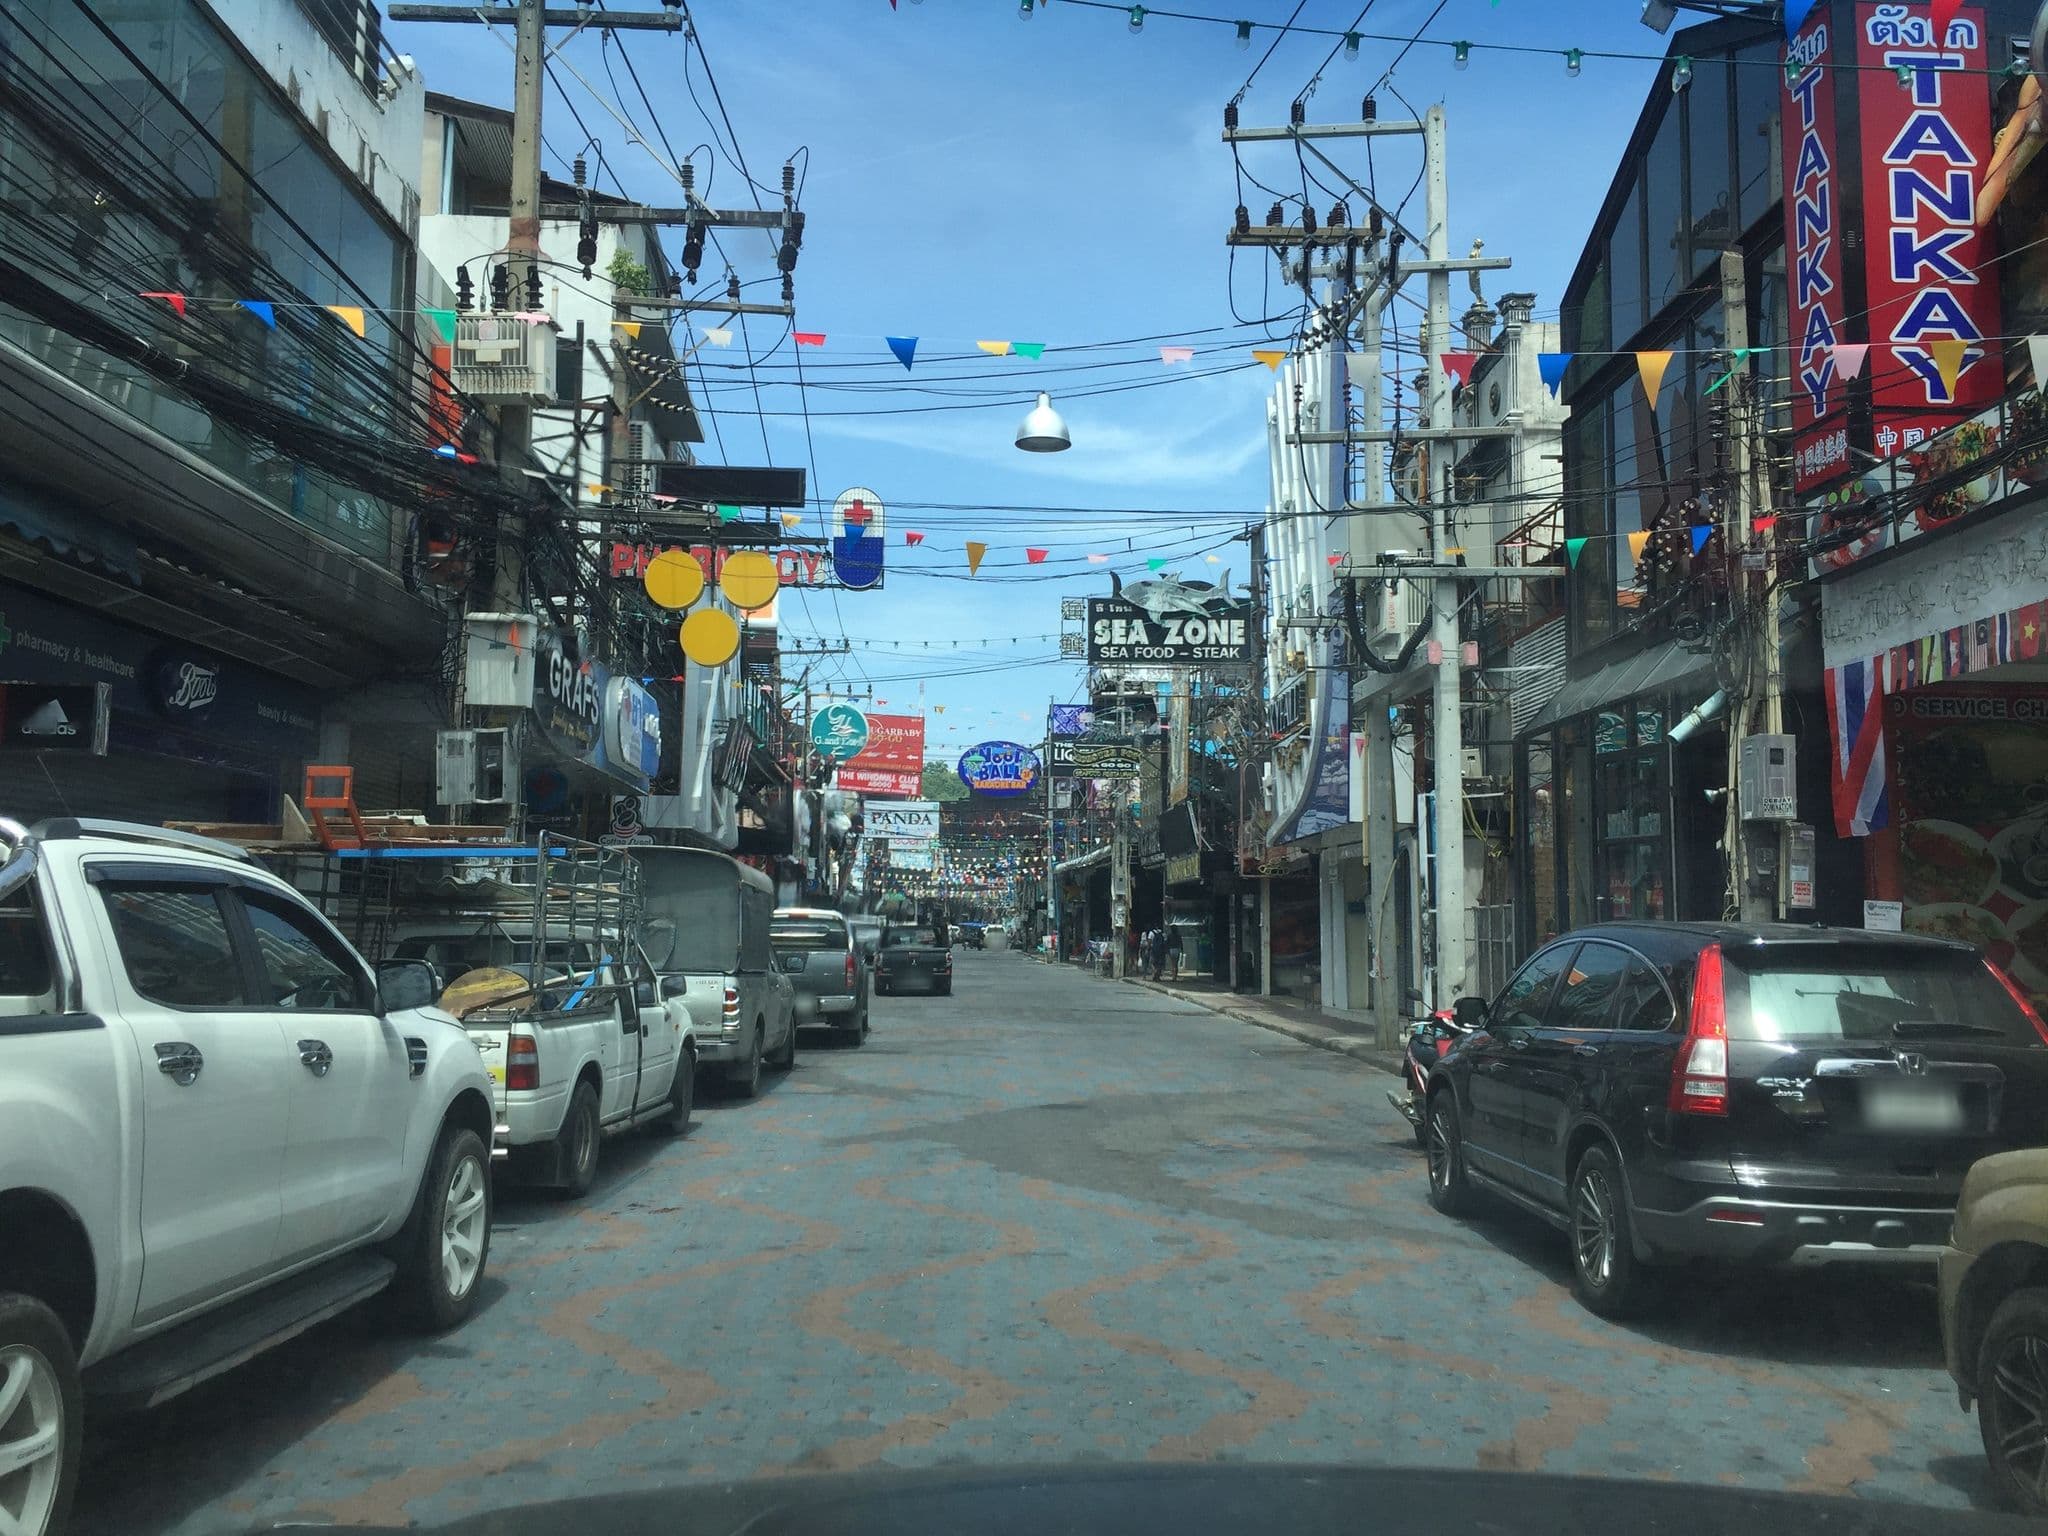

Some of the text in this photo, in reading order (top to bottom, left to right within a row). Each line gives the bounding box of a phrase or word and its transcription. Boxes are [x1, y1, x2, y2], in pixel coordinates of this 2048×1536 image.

[1866, 4, 1978, 49] ตังก
[1792, 64, 1836, 419] TANKAY
[1882, 51, 1985, 404] TANKAY
[16, 631, 135, 678] pharmacy & healthcare
[1094, 619, 1149, 645] SEA
[1163, 619, 1245, 645] ZONE
[1100, 647, 1128, 658] SEA
[1134, 647, 1174, 658] FOOD
[1193, 647, 1240, 659] STEAK
[169, 662, 217, 709] Boots
[549, 649, 599, 725] GRAFS
[1911, 697, 2008, 718] SERVICE
[840, 771, 920, 785] THE WINDMILL CLUB
[871, 811, 933, 825] PANDA
